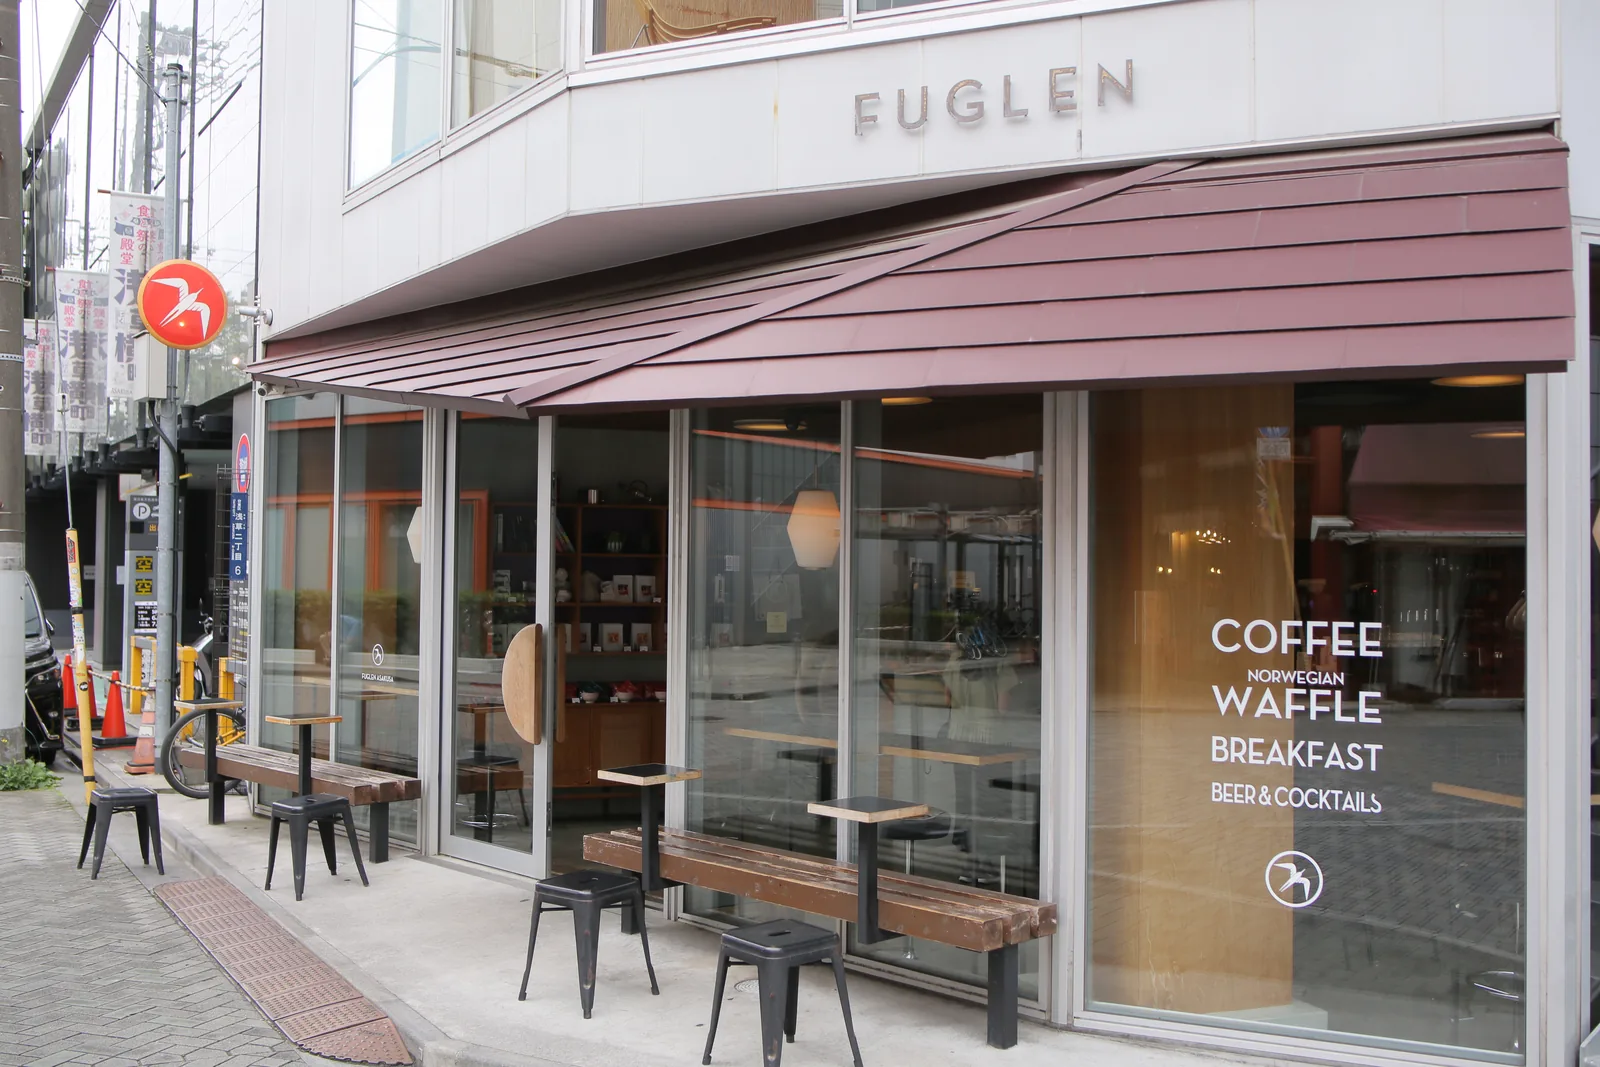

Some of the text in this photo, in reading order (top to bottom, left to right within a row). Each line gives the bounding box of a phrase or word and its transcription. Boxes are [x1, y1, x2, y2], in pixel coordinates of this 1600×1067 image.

[855, 59, 1133, 136] FUGLEN
[120, 237, 135, 265] 殿堂
[234, 512, 243, 561] 浅草二丁目
[135, 555, 153, 573] 空
[234, 565, 242, 576] 6
[135, 578, 153, 596] 空
[1211, 618, 1383, 657] COFFEE
[1247, 669, 1345, 686] NORWEGIAN
[1211, 685, 1382, 724] WAFFLE
[1211, 735, 1383, 772] BREAKFAST
